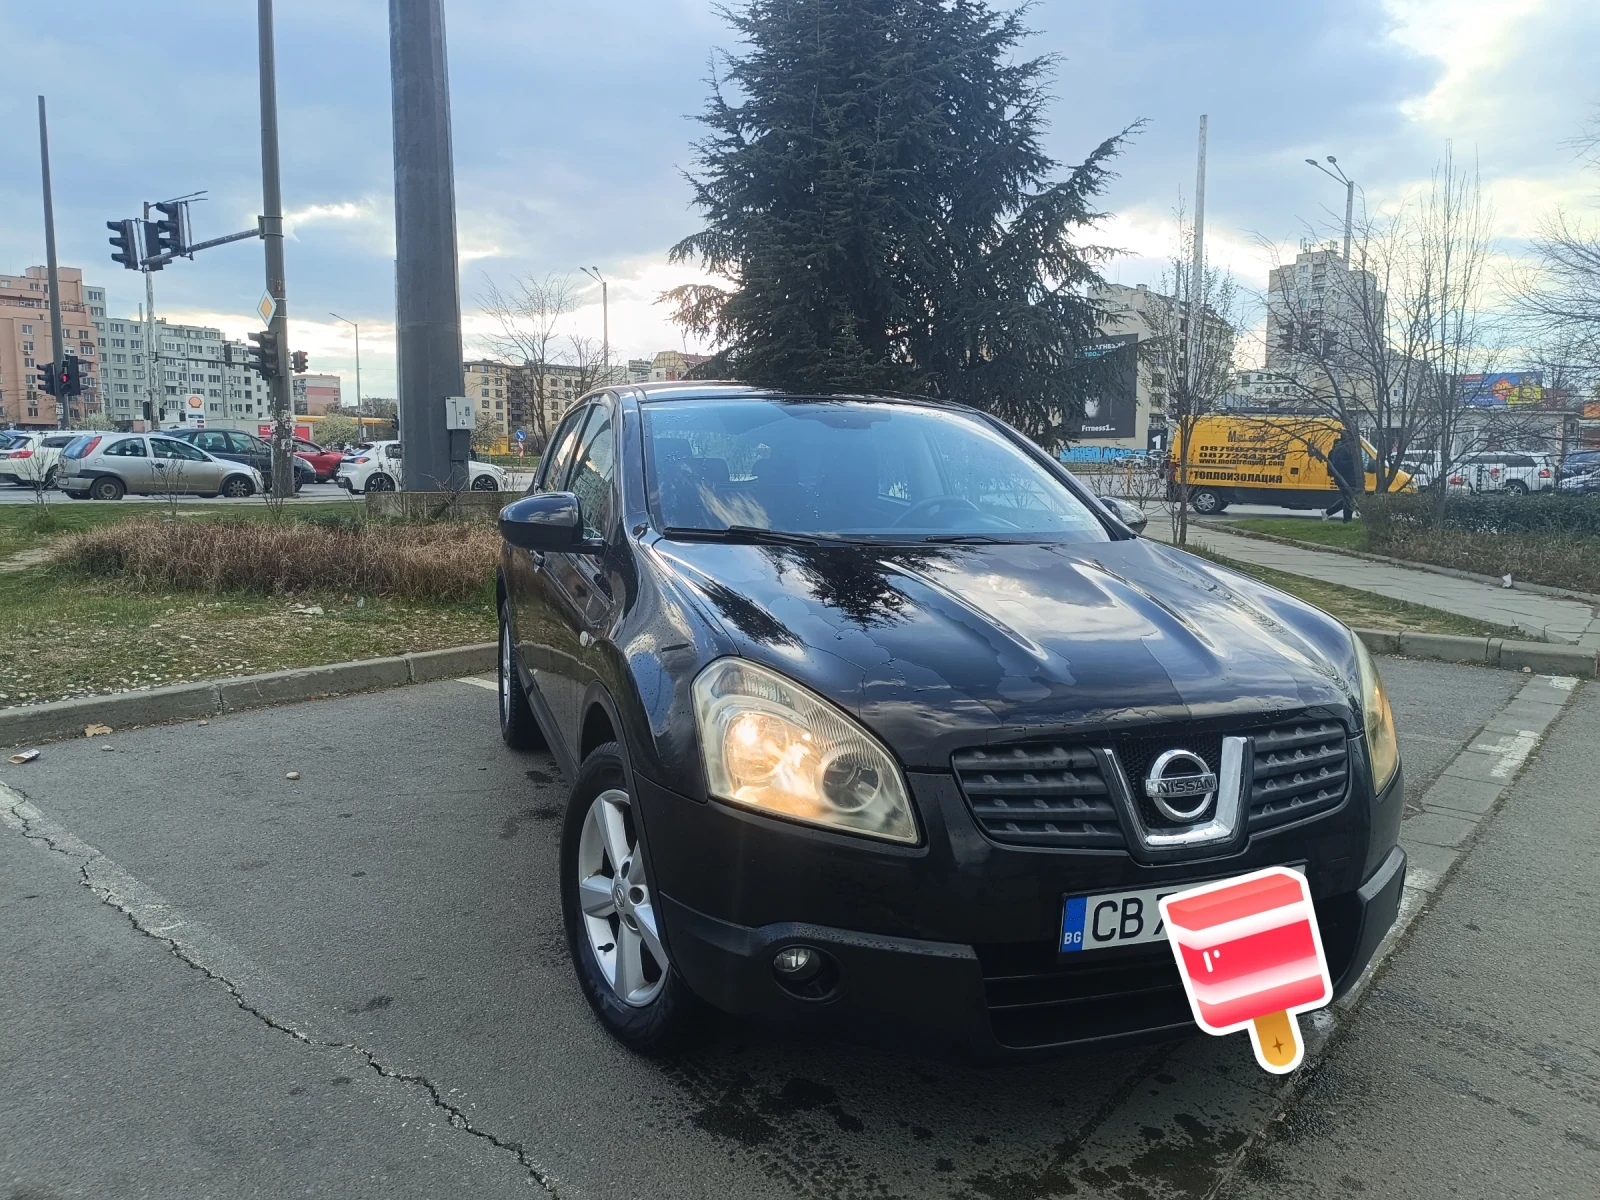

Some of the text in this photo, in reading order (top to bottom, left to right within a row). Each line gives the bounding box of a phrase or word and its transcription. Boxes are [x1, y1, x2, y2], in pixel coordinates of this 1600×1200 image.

[1193, 470, 1283, 484] ТОПЛОИЗОЛАЦИЯ
[1157, 777, 1214, 794] NISSAN
[1064, 931, 1082, 945] BG
